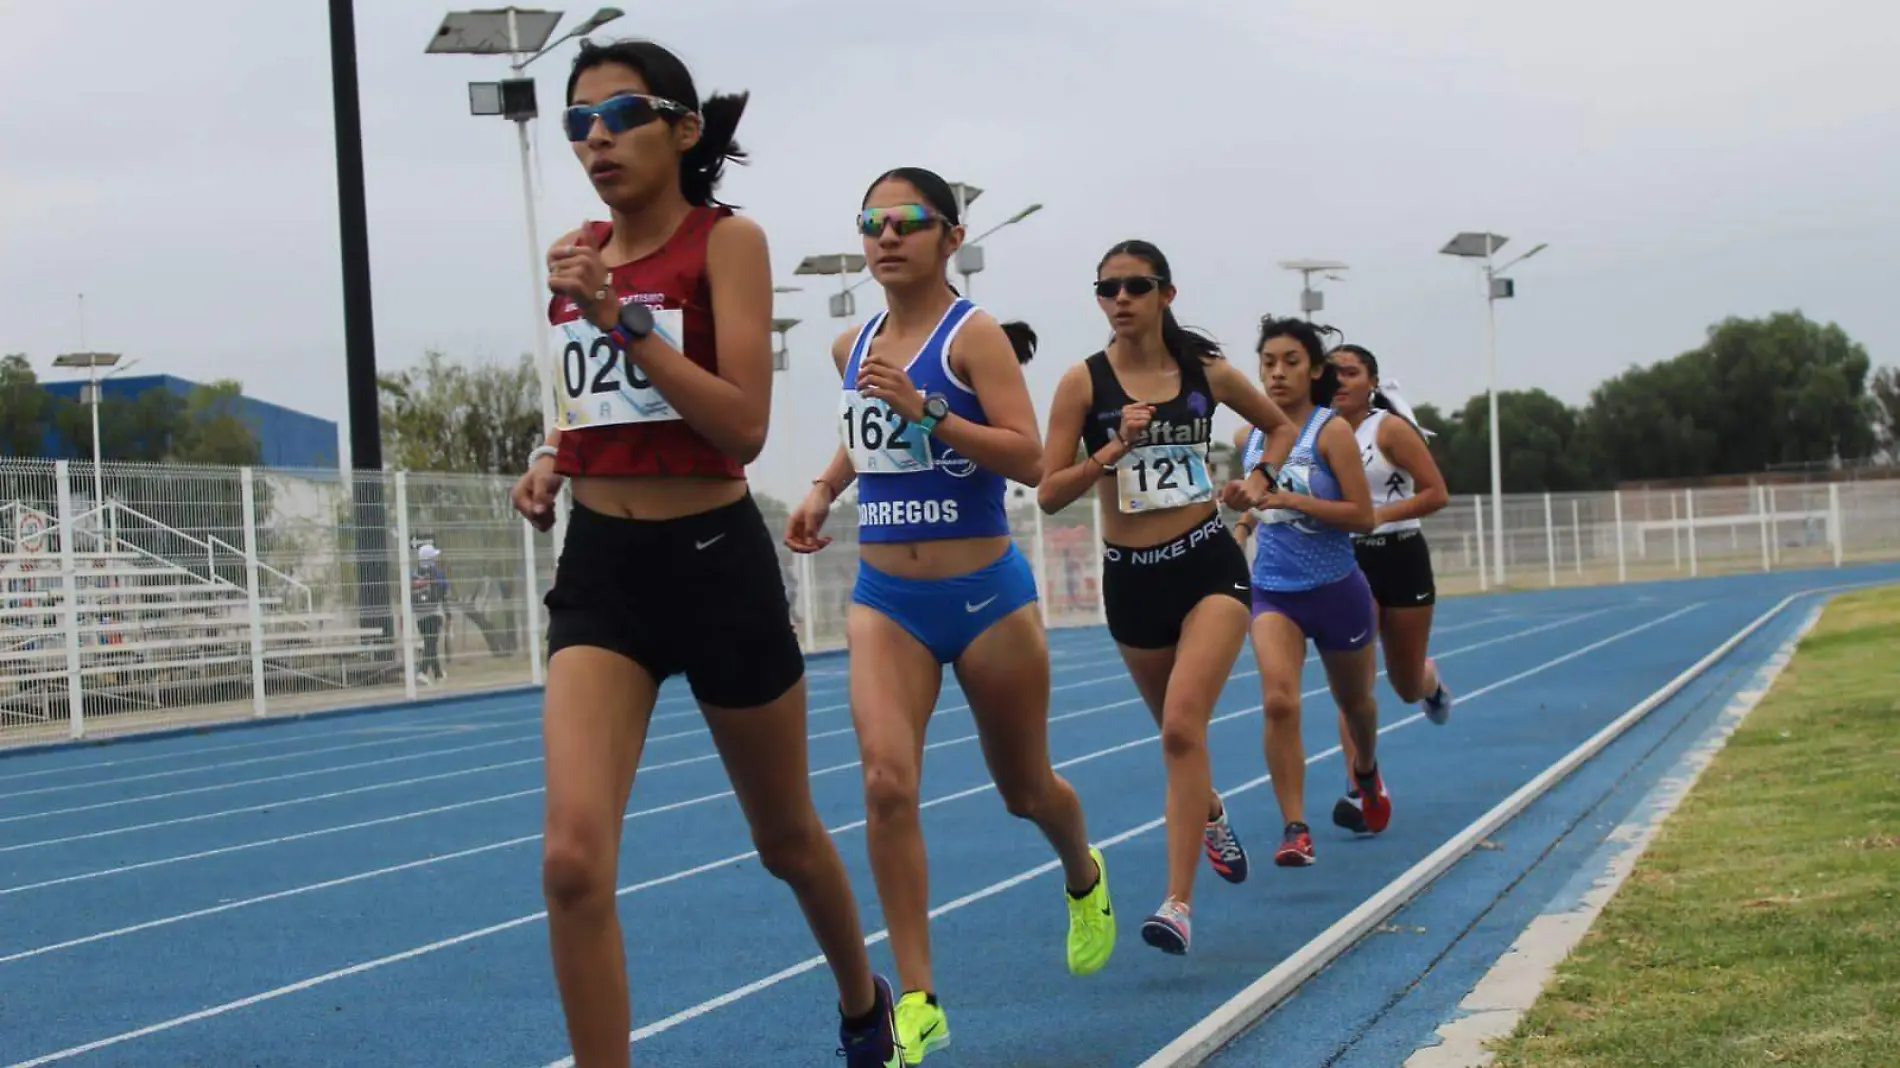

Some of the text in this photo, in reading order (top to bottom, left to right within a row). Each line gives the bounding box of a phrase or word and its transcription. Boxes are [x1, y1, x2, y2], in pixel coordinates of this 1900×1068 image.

[843, 406, 912, 450] 162
[1107, 417, 1208, 444] eftali
[1132, 454, 1195, 492] 121
[857, 499, 959, 526] ORREGOS
[1132, 539, 1187, 565] NIKE
[1190, 514, 1224, 548] PRO
